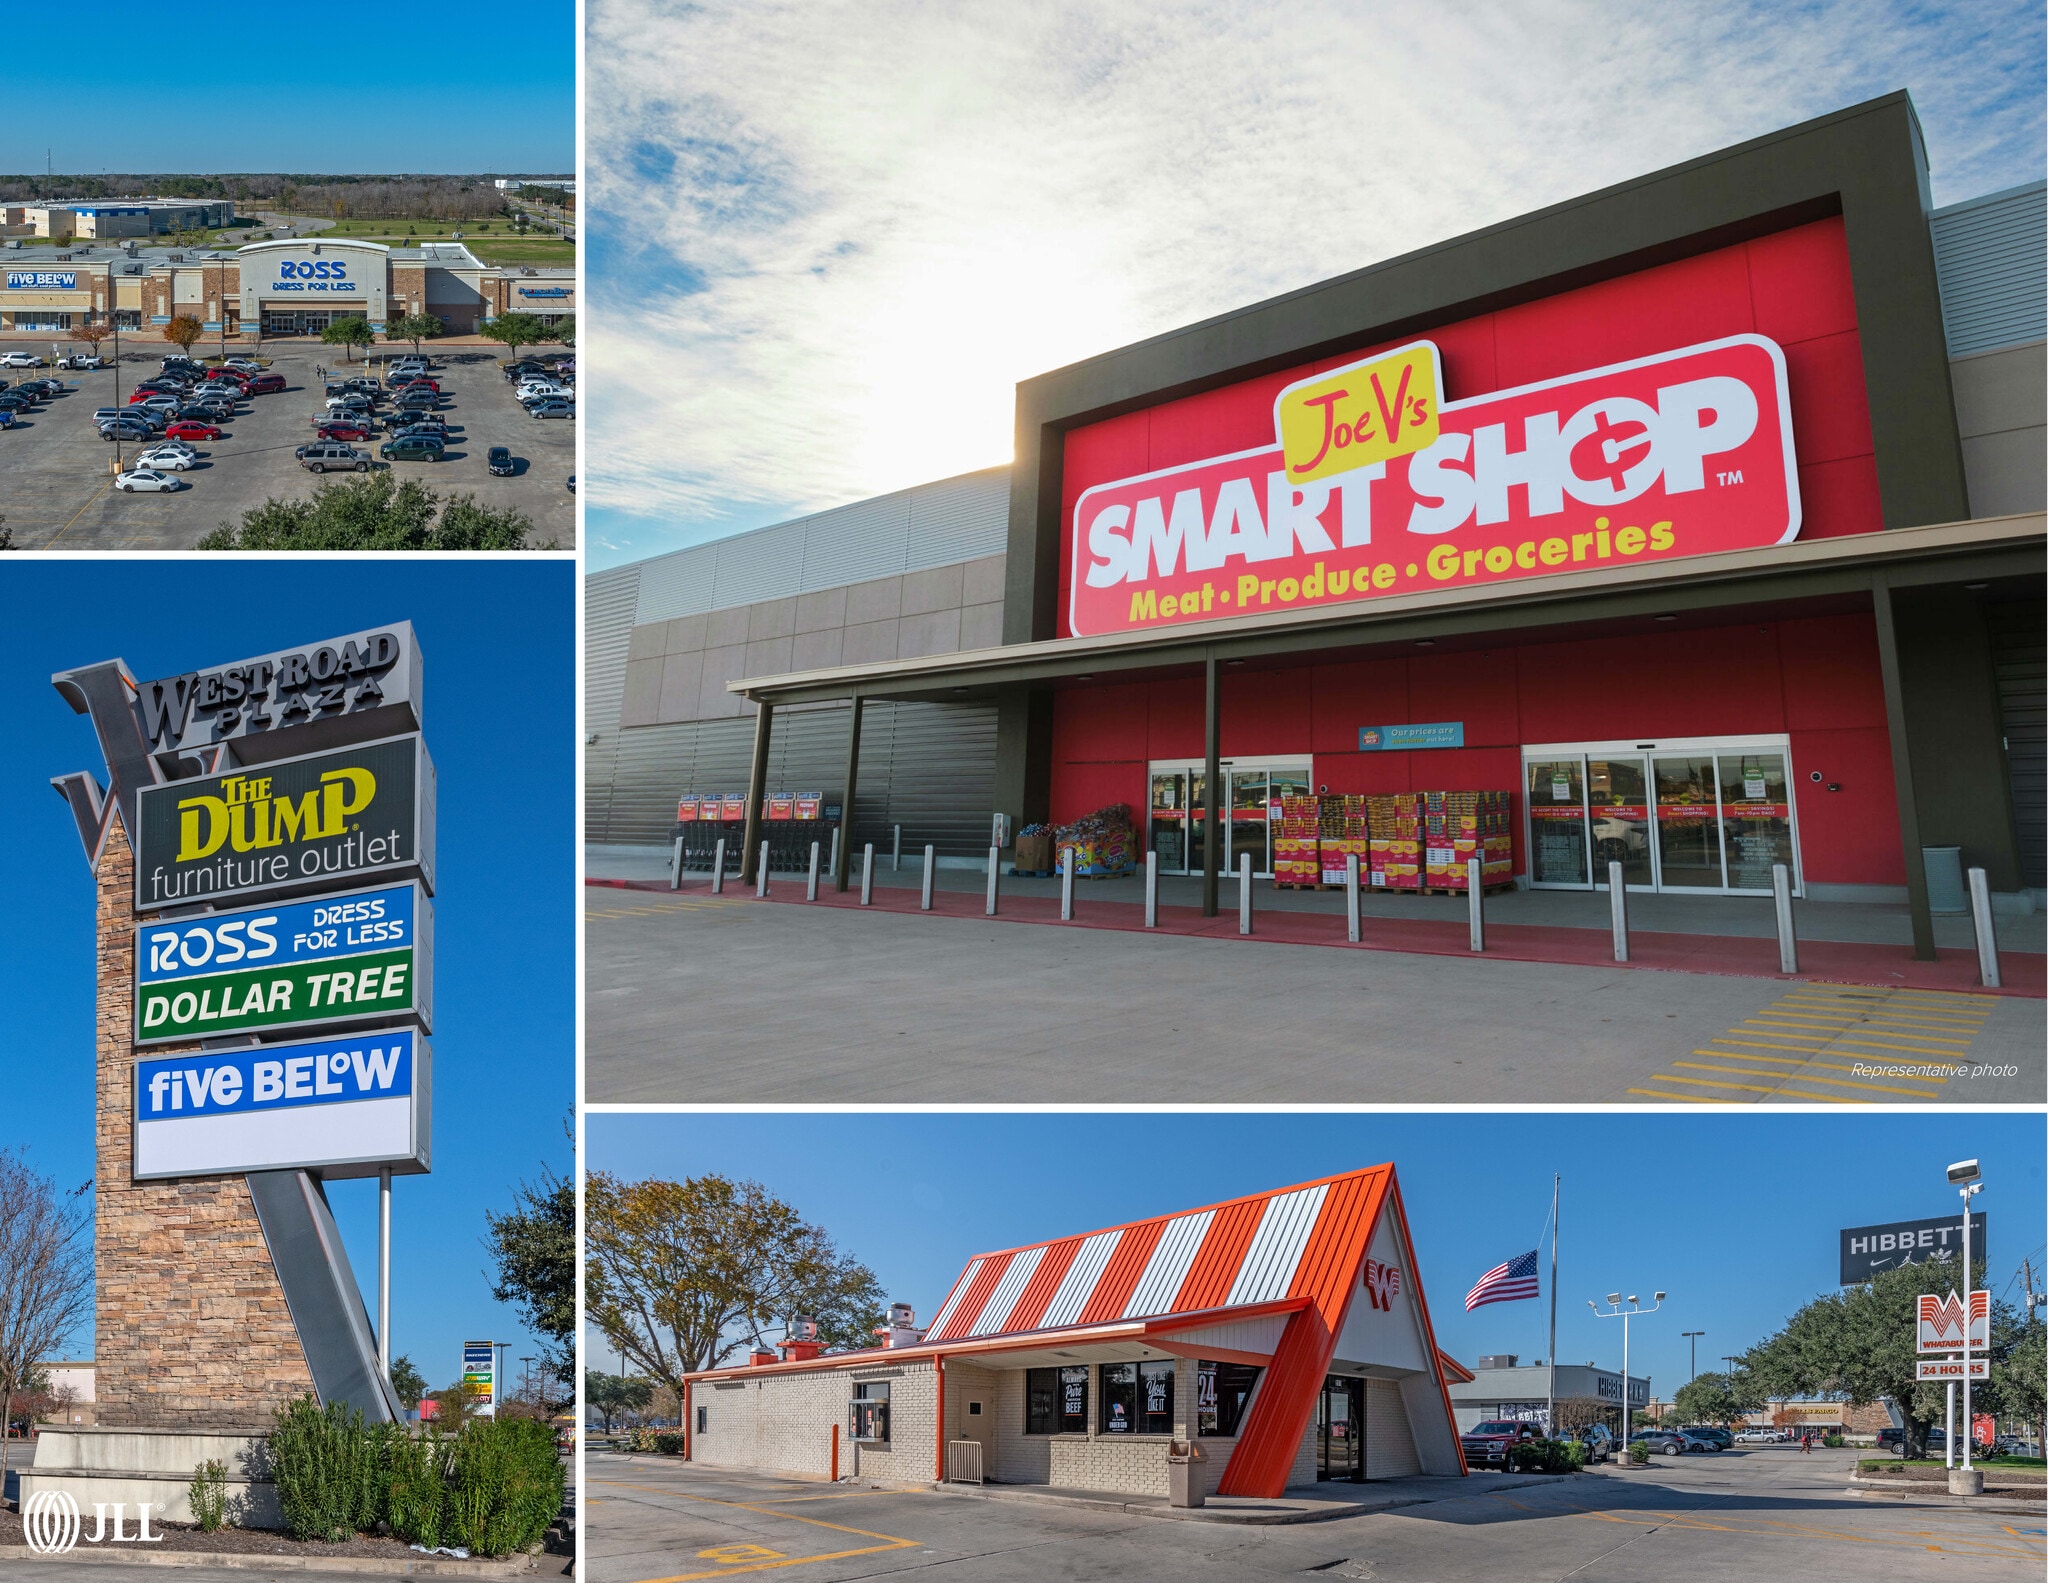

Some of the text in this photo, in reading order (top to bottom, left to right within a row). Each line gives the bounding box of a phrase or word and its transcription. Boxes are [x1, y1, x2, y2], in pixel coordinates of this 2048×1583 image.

[8, 273, 35, 284] five
[281, 261, 346, 279] ROSS
[272, 282, 356, 291] DRESS FOR LESS
[1085, 460, 1386, 588] SMART
[1407, 376, 1758, 534] SHOP
[1129, 517, 1675, 622] Meat Produce Groceries
[136, 633, 400, 744] WEST ROAD
[216, 676, 384, 733] PLAZA
[1409, 728, 1436, 737] prices
[221, 776, 272, 807] THE
[175, 767, 377, 862] DUMP
[151, 829, 400, 900] furniture outlet
[313, 899, 385, 927] DRESS
[150, 916, 277, 972] ROSS
[294, 920, 404, 952] FOR LESS
[143, 963, 408, 1027] DOLLAR TREE
[149, 1065, 243, 1112] five
[1922, 1366, 1936, 1375] 24
[1065, 1384, 1083, 1399] Pure
[1146, 1379, 1166, 1400] You
[1198, 1375, 1215, 1406] 24
[1065, 1402, 1082, 1413] BEEF
